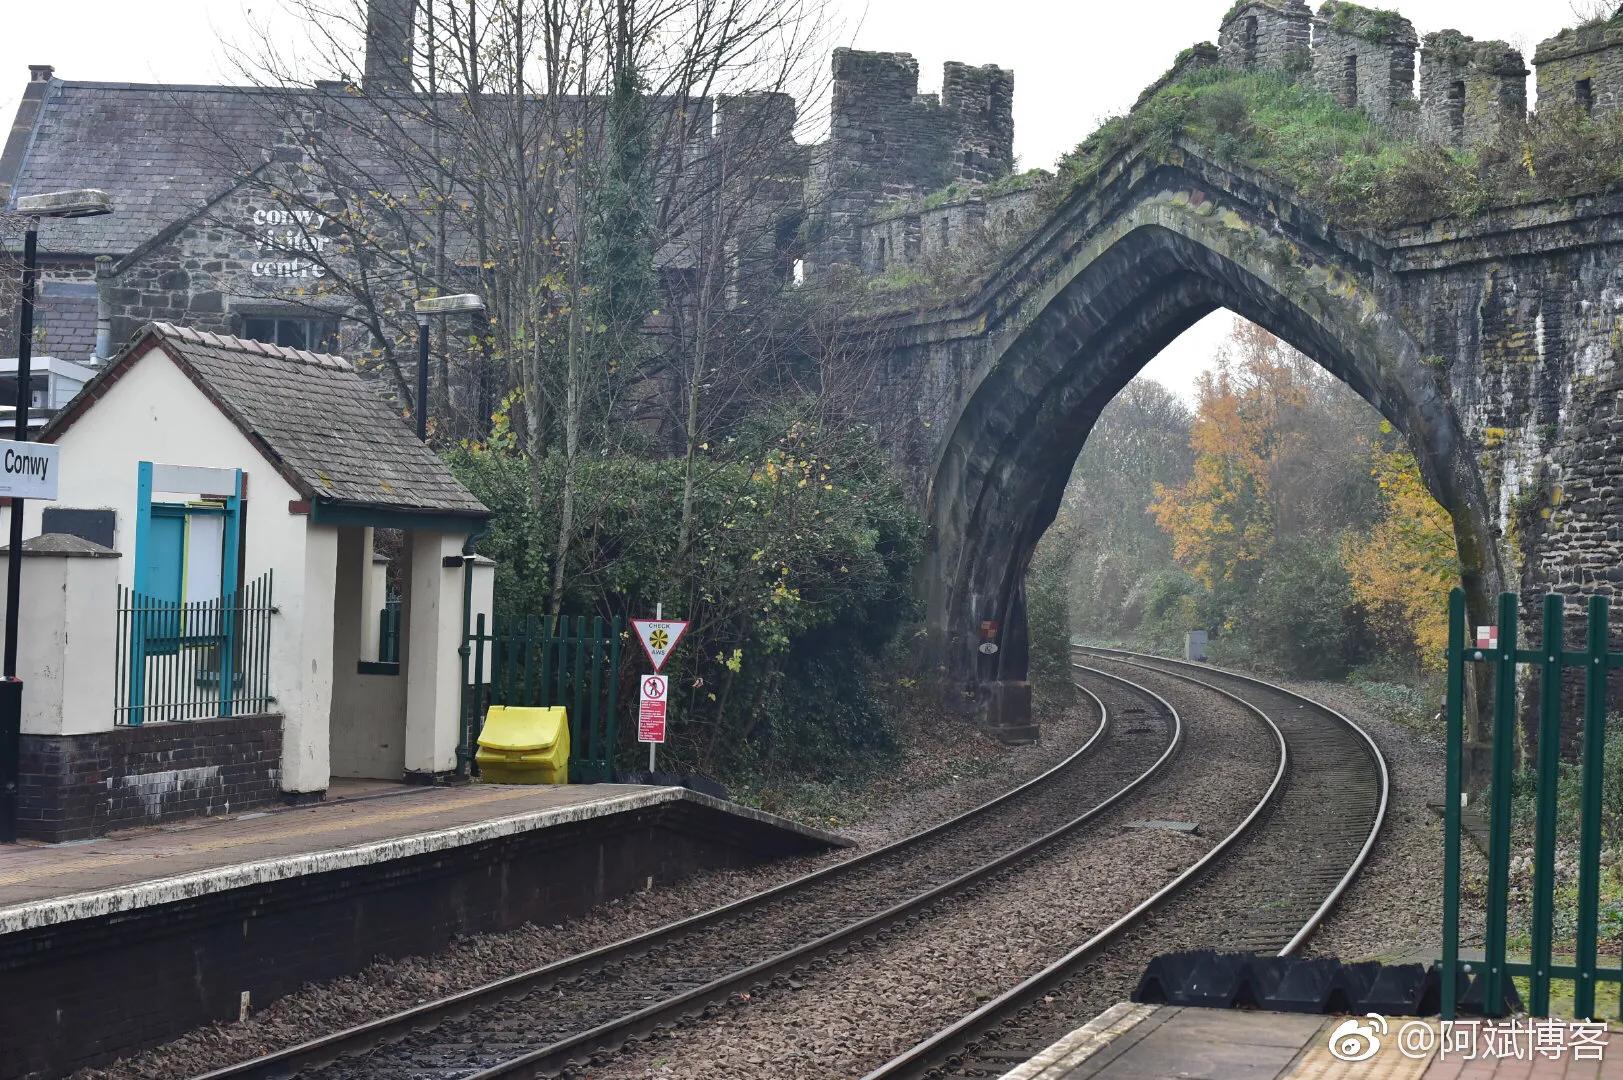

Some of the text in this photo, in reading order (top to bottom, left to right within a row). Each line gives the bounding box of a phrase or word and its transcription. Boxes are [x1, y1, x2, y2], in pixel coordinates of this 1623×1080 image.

[253, 209, 326, 230] conwy
[251, 257, 326, 277] centre
[5, 448, 49, 481] Conwy
